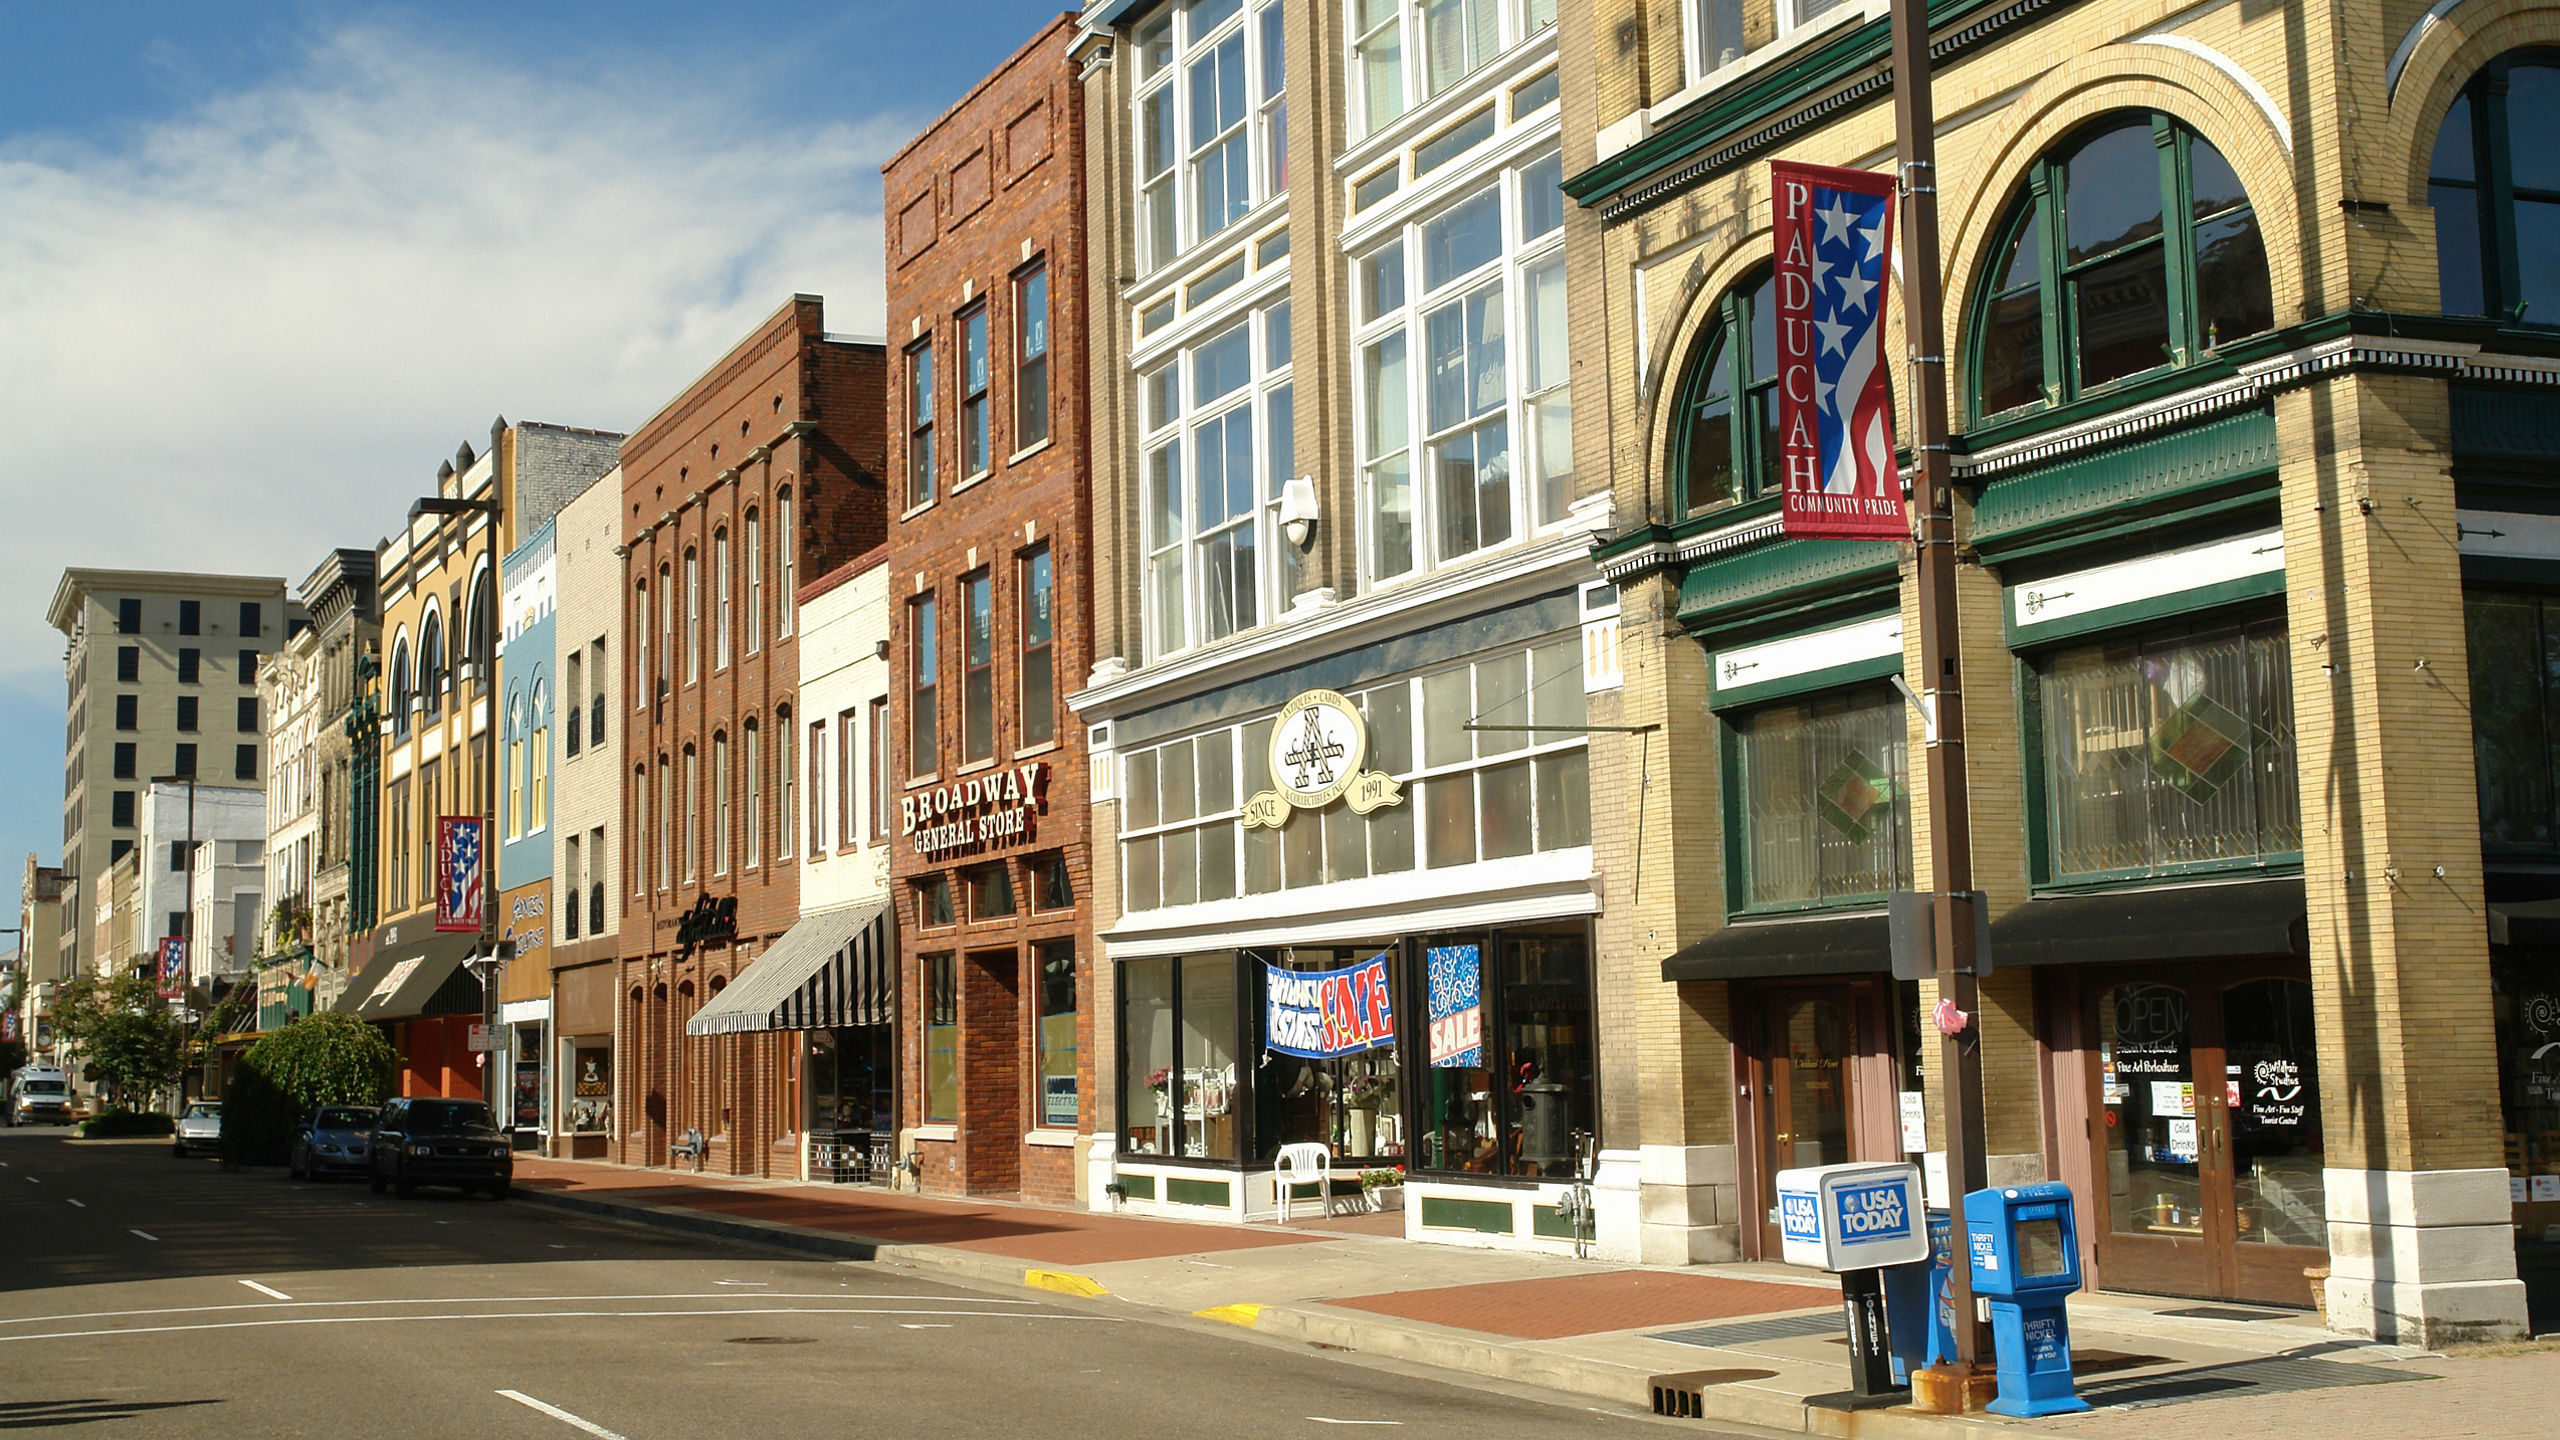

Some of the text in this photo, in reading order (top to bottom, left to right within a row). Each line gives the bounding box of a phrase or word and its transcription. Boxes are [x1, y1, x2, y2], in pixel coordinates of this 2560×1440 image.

[1783, 182, 1820, 494] PADUCAH
[1791, 495, 1898, 517] COMMUNITY PRIDE
[1283, 691, 1342, 719] ANTIQUES CARDS
[901, 762, 1039, 837] BROADWAY
[1361, 780, 1383, 802] 1991
[1250, 799, 1276, 822] SINCE
[914, 806, 1025, 854] GENERAL STORE
[439, 821, 452, 918] PADUCAH
[1320, 962, 1395, 1054] SALE
[2116, 996, 2183, 1034] OPEN
[1430, 1008, 1480, 1059] SALE
[2270, 1073, 2299, 1086] Studios
[2174, 1123, 2190, 1135] Cold
[2171, 1138, 2195, 1151] Drinks
[1794, 1199, 1815, 1216] USA
[1861, 1189, 1902, 1212] USA
[1785, 1214, 1817, 1234] TODAY
[1842, 1208, 1904, 1234] TODAY
[1971, 1233, 1994, 1243] THRIFTY
[1973, 1242, 1994, 1252] NICKEL
[1866, 1299, 1878, 1357] GANNETT
[2023, 1317, 2056, 1332] THRIFTY
[2025, 1328, 2057, 1341] NICKEL
